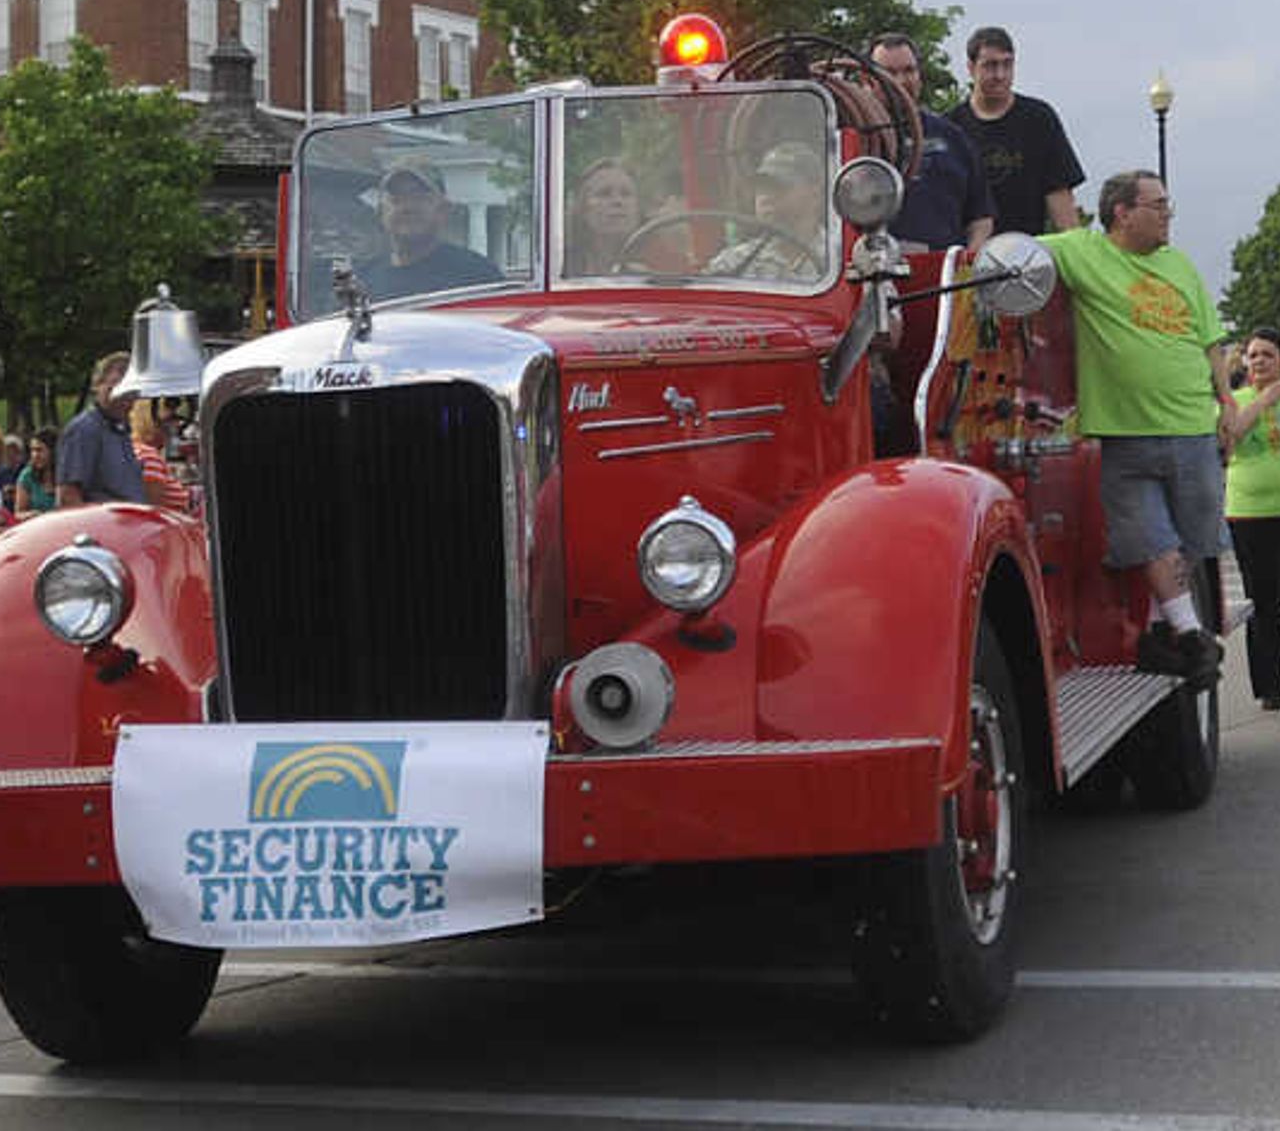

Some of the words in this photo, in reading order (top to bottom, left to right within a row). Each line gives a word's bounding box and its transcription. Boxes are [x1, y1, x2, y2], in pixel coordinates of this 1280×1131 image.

[314, 365, 373, 388] Mack
[185, 826, 459, 875] SECURITY
[198, 873, 446, 923] FINANCE
